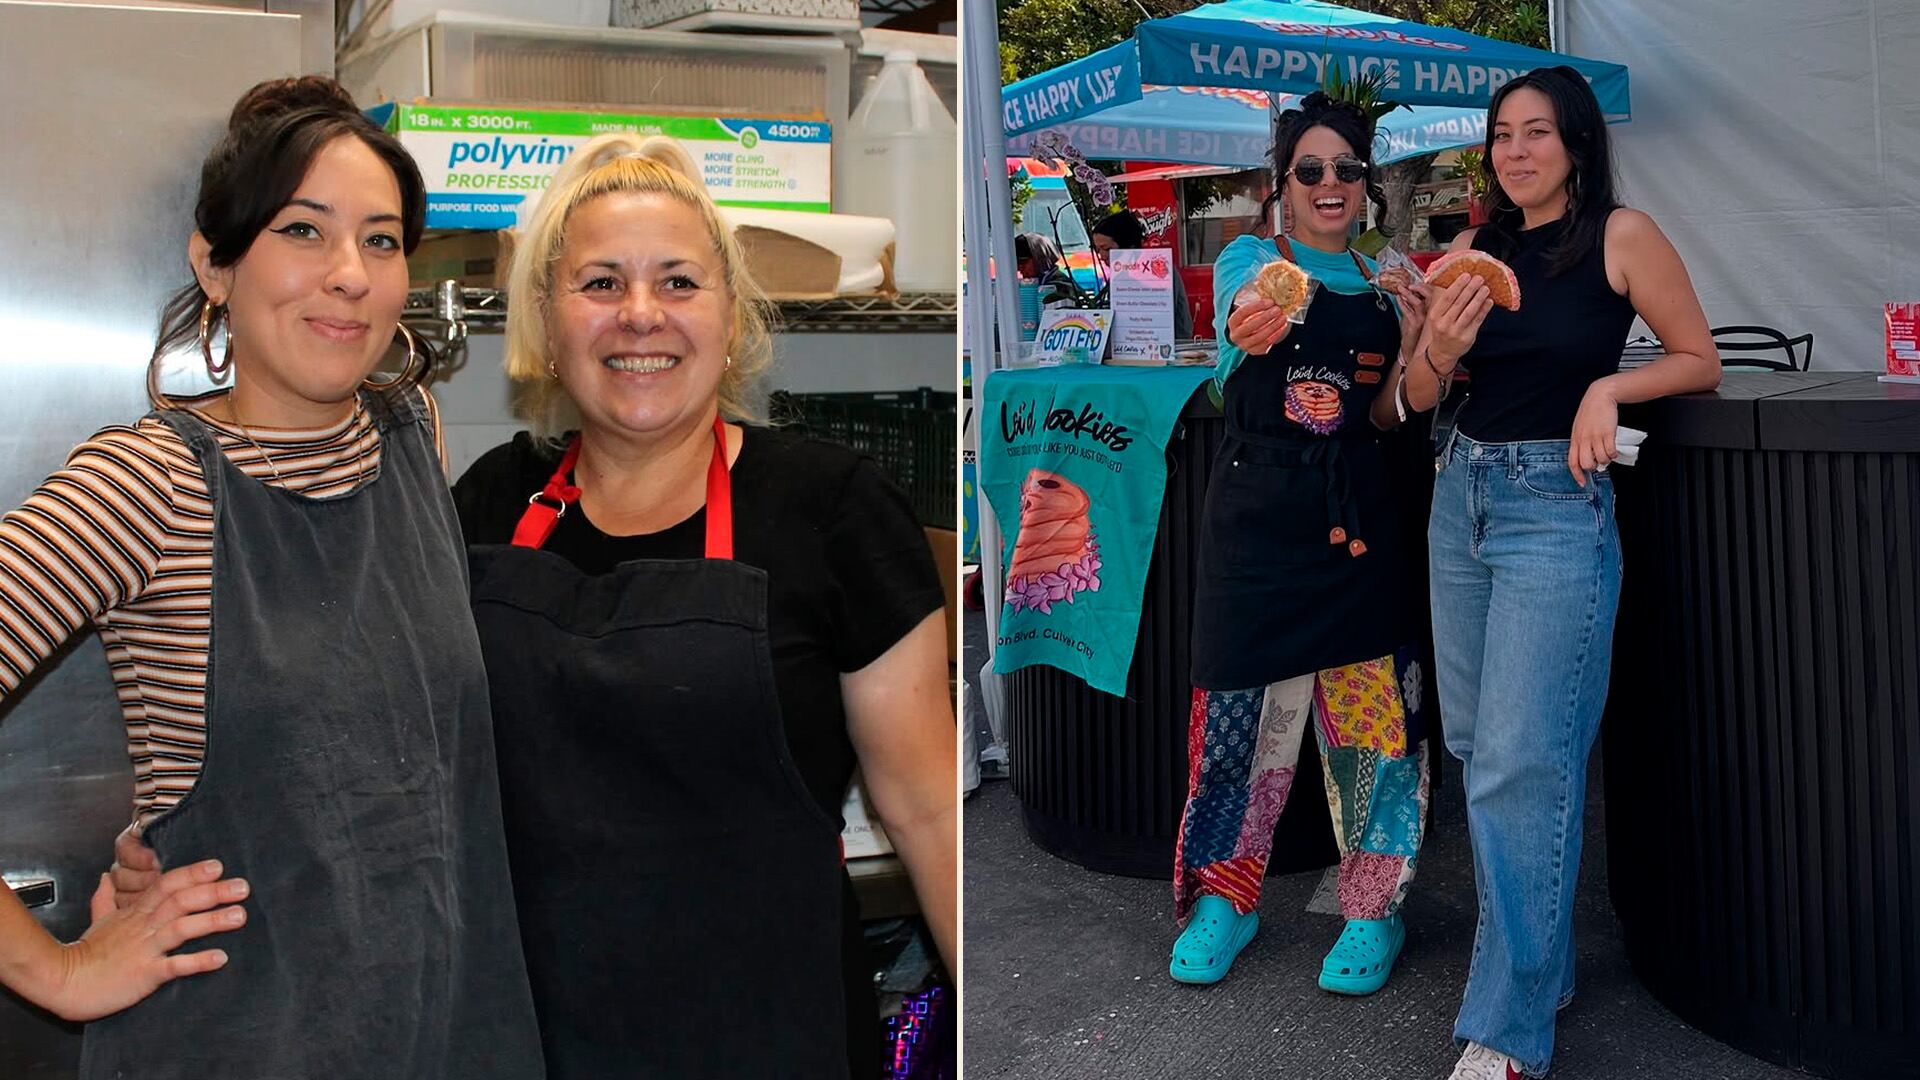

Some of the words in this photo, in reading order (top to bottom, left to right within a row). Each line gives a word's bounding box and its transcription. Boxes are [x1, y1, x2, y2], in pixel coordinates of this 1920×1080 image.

[1190, 42, 1334, 84] HAPPY
[1024, 76, 1084, 123] HAPPY
[409, 113, 429, 127] 18
[467, 116, 514, 129] 3000
[515, 121, 532, 130] FT.
[592, 124, 624, 133] MADE
[626, 125, 638, 133] IN
[640, 126, 662, 135] USA
[768, 125, 810, 138] 4500
[704, 153, 733, 162] MORE
[735, 155, 765, 164] CLING
[704, 165, 733, 174] MORE
[735, 167, 779, 176] STRETCH
[704, 178, 733, 187] MORE
[735, 179, 786, 189] STRENGTH
[429, 203, 472, 212] PURPOSE
[473, 204, 500, 212] FOOD
[1044, 328, 1070, 351] GOT
[1315, 366, 1351, 390] Cookies
[1043, 441, 1062, 454] LIKE
[1063, 443, 1079, 456] YOU
[1079, 447, 1095, 460] JUST
[1014, 628, 1039, 643] Blvd.
[1042, 628, 1075, 647] Culver
[1076, 641, 1095, 660] City
